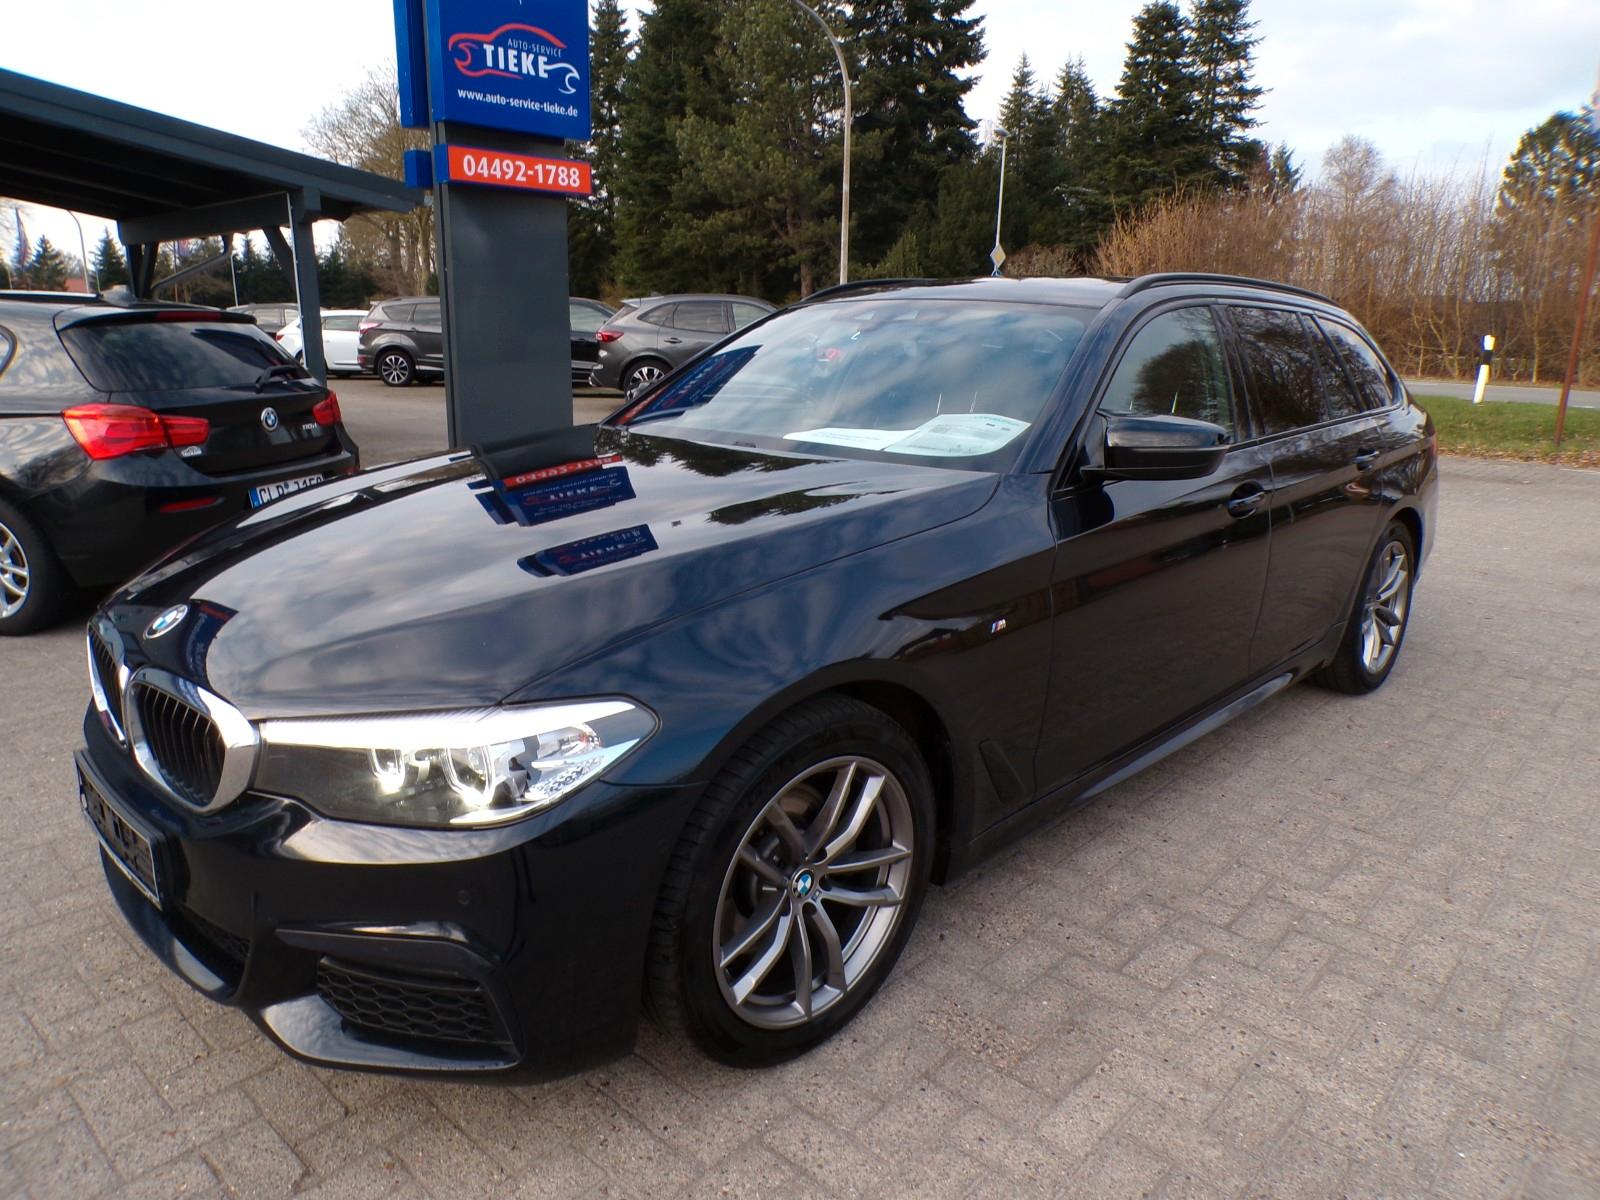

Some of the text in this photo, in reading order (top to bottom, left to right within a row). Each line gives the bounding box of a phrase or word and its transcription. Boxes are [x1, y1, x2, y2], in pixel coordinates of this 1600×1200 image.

[483, 43, 549, 79] TIEKE
[508, 37, 563, 58] AUTO-SERVICE
[457, 88, 579, 117] www.auto-service-tieke.de
[463, 154, 581, 188] 04492-1788
